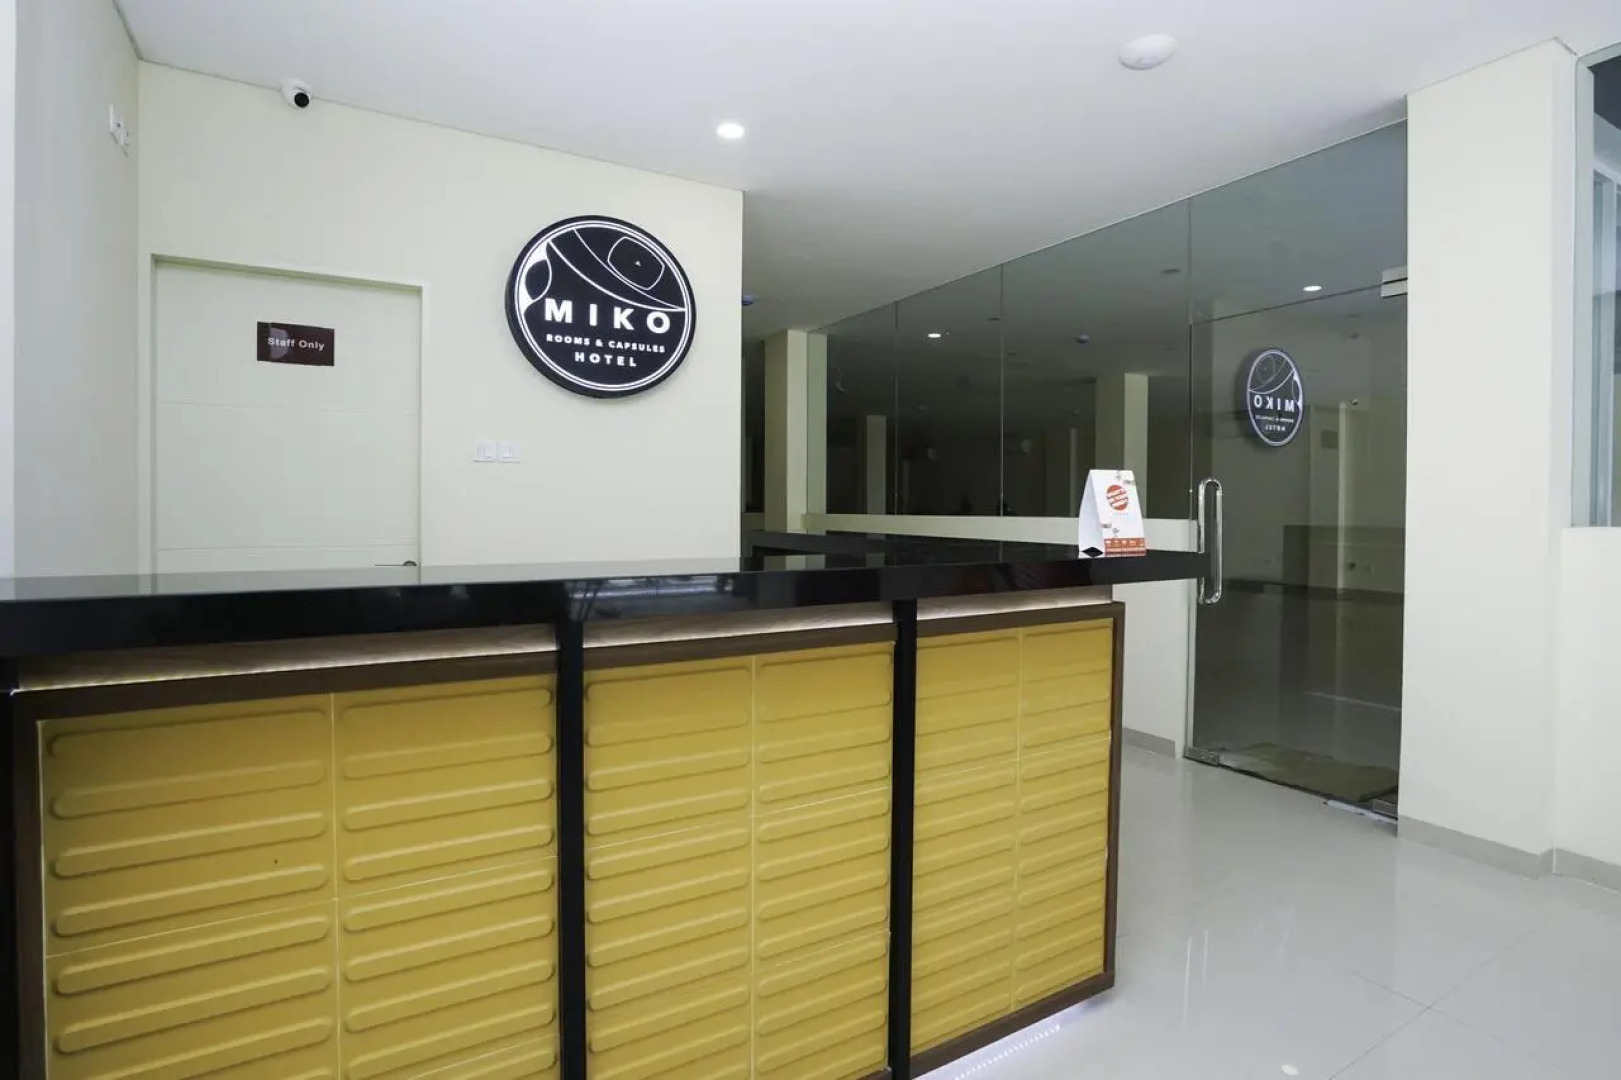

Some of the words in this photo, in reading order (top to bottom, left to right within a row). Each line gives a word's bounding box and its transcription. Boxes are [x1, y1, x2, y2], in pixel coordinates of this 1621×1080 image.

[544, 297, 671, 334] MIKO
[267, 337, 295, 347] Staff
[298, 339, 325, 351] Only
[546, 333, 590, 346] ROOMS
[595, 339, 603, 347] &
[608, 340, 665, 353] CAPSULES
[574, 351, 637, 367] HOTEL
